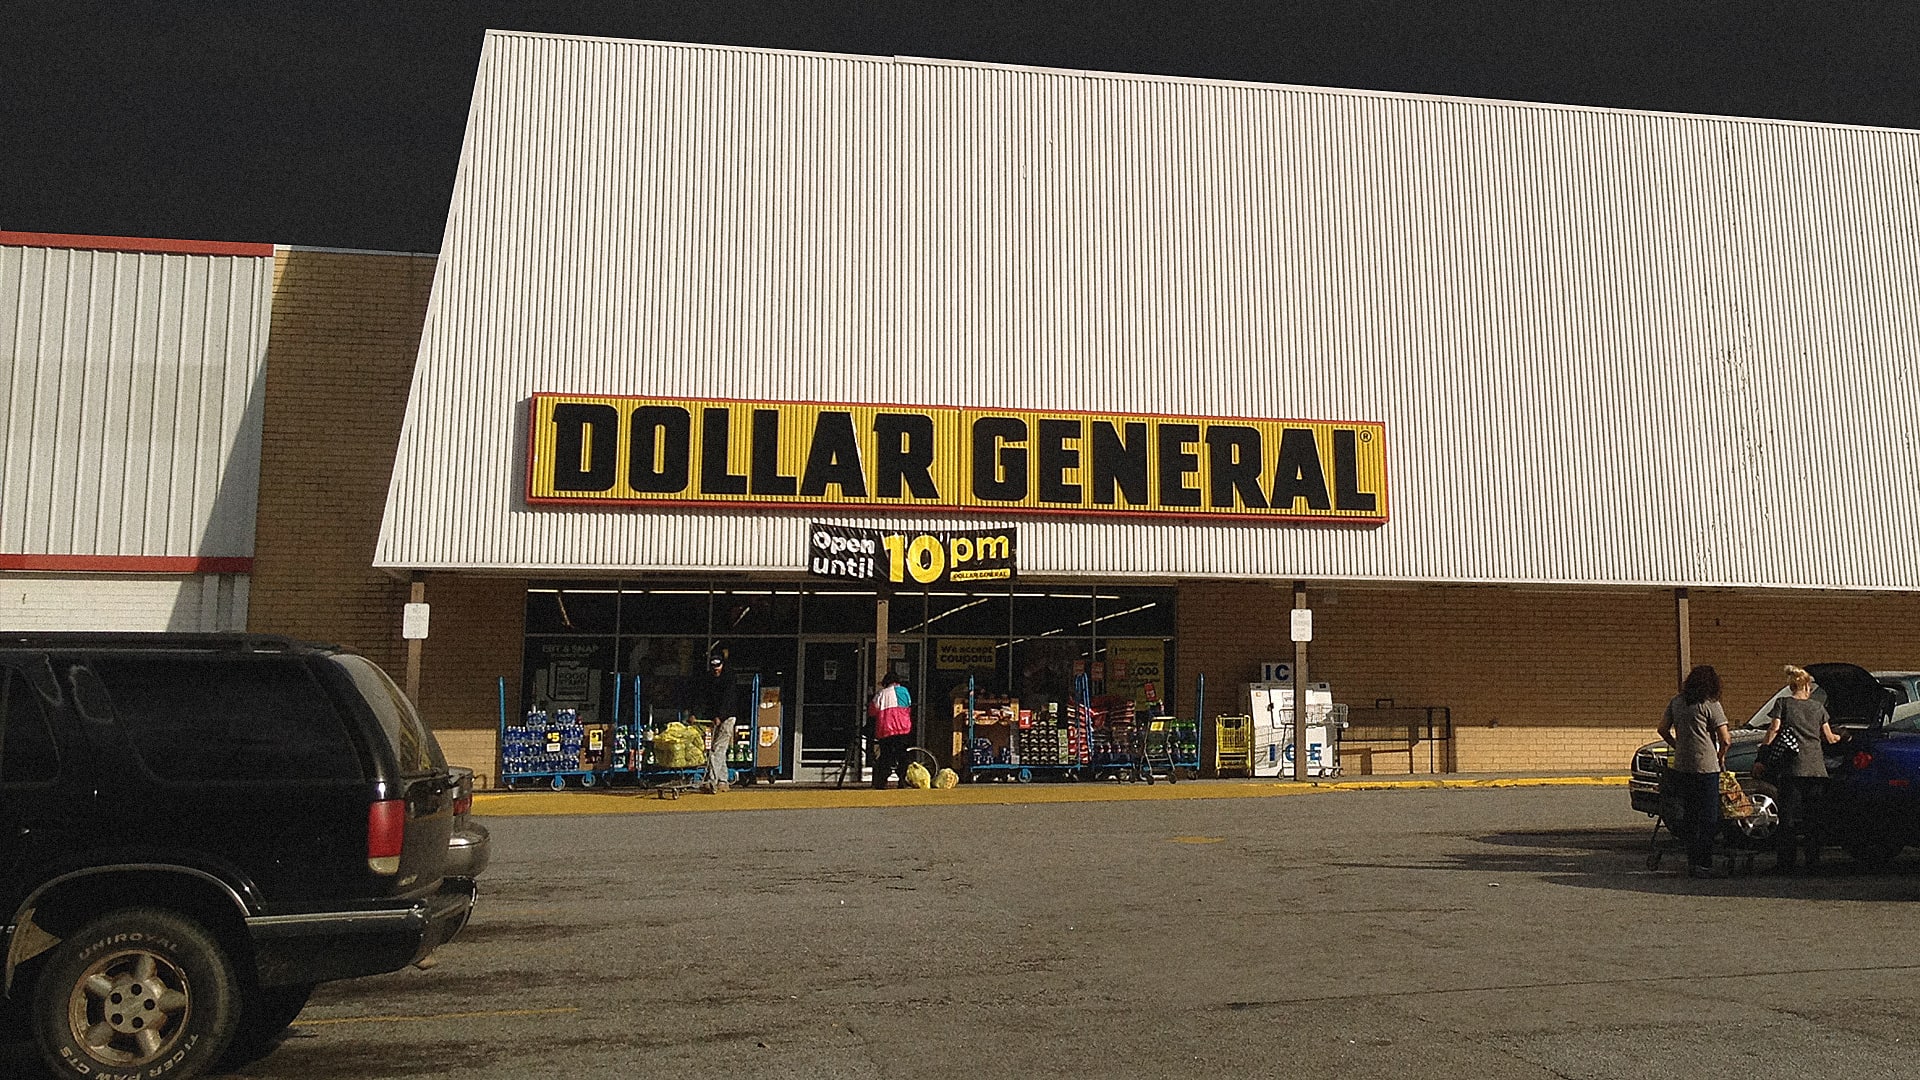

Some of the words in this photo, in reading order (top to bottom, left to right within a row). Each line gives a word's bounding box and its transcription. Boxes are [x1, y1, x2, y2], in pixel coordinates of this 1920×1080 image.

[552, 402, 940, 499] DOLLAR
[972, 416, 1377, 512] GENERAL
[812, 531, 875, 555] Open
[812, 556, 875, 579] until
[884, 534, 946, 584] 10
[950, 535, 1009, 568] pm
[940, 645, 957, 653] We
[959, 645, 993, 654] accept
[940, 654, 993, 664] coupons
[546, 731, 560, 742] $5
[591, 731, 602, 742] $1
[79, 932, 178, 960] UNIROYAL
[148, 1033, 199, 1078] TIGER
